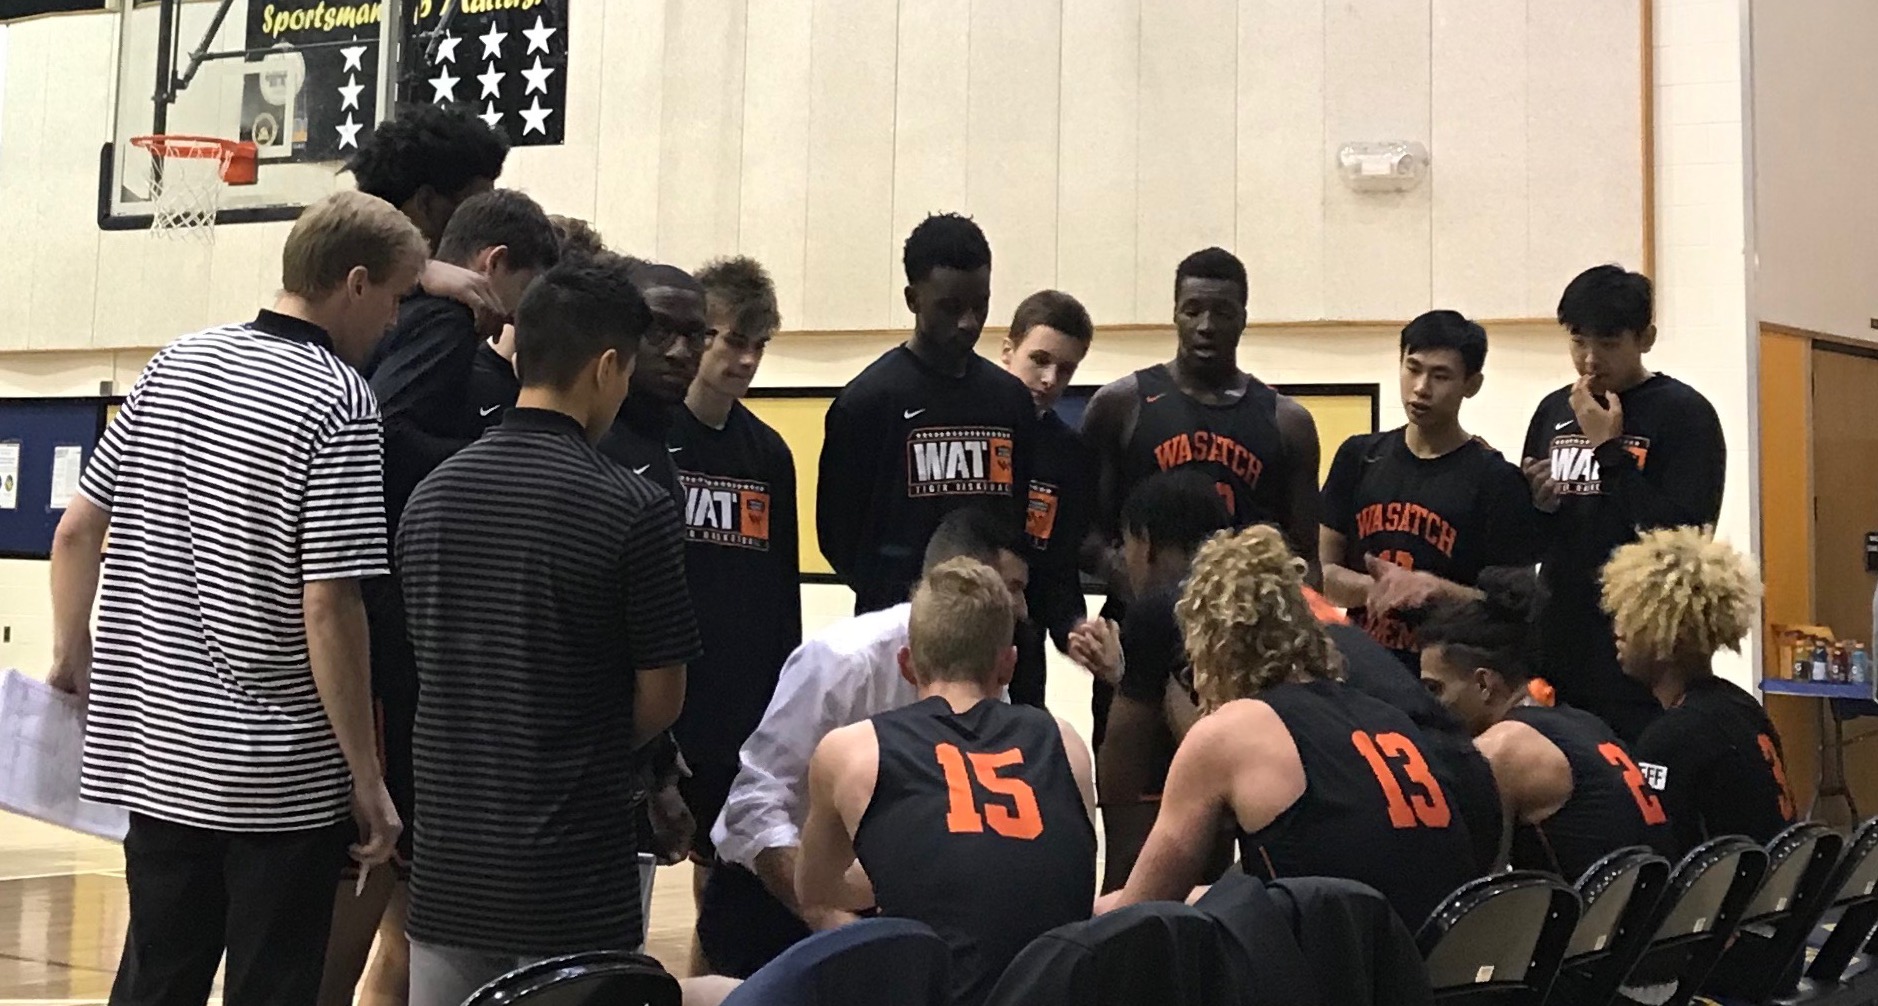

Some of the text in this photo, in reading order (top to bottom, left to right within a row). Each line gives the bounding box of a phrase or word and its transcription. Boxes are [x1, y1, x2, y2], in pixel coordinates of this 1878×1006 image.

[1154, 431, 1263, 490] WASATCH
[1356, 502, 1457, 556] WASATCH
[935, 742, 1043, 840] 15
[1352, 730, 1451, 828] 13
